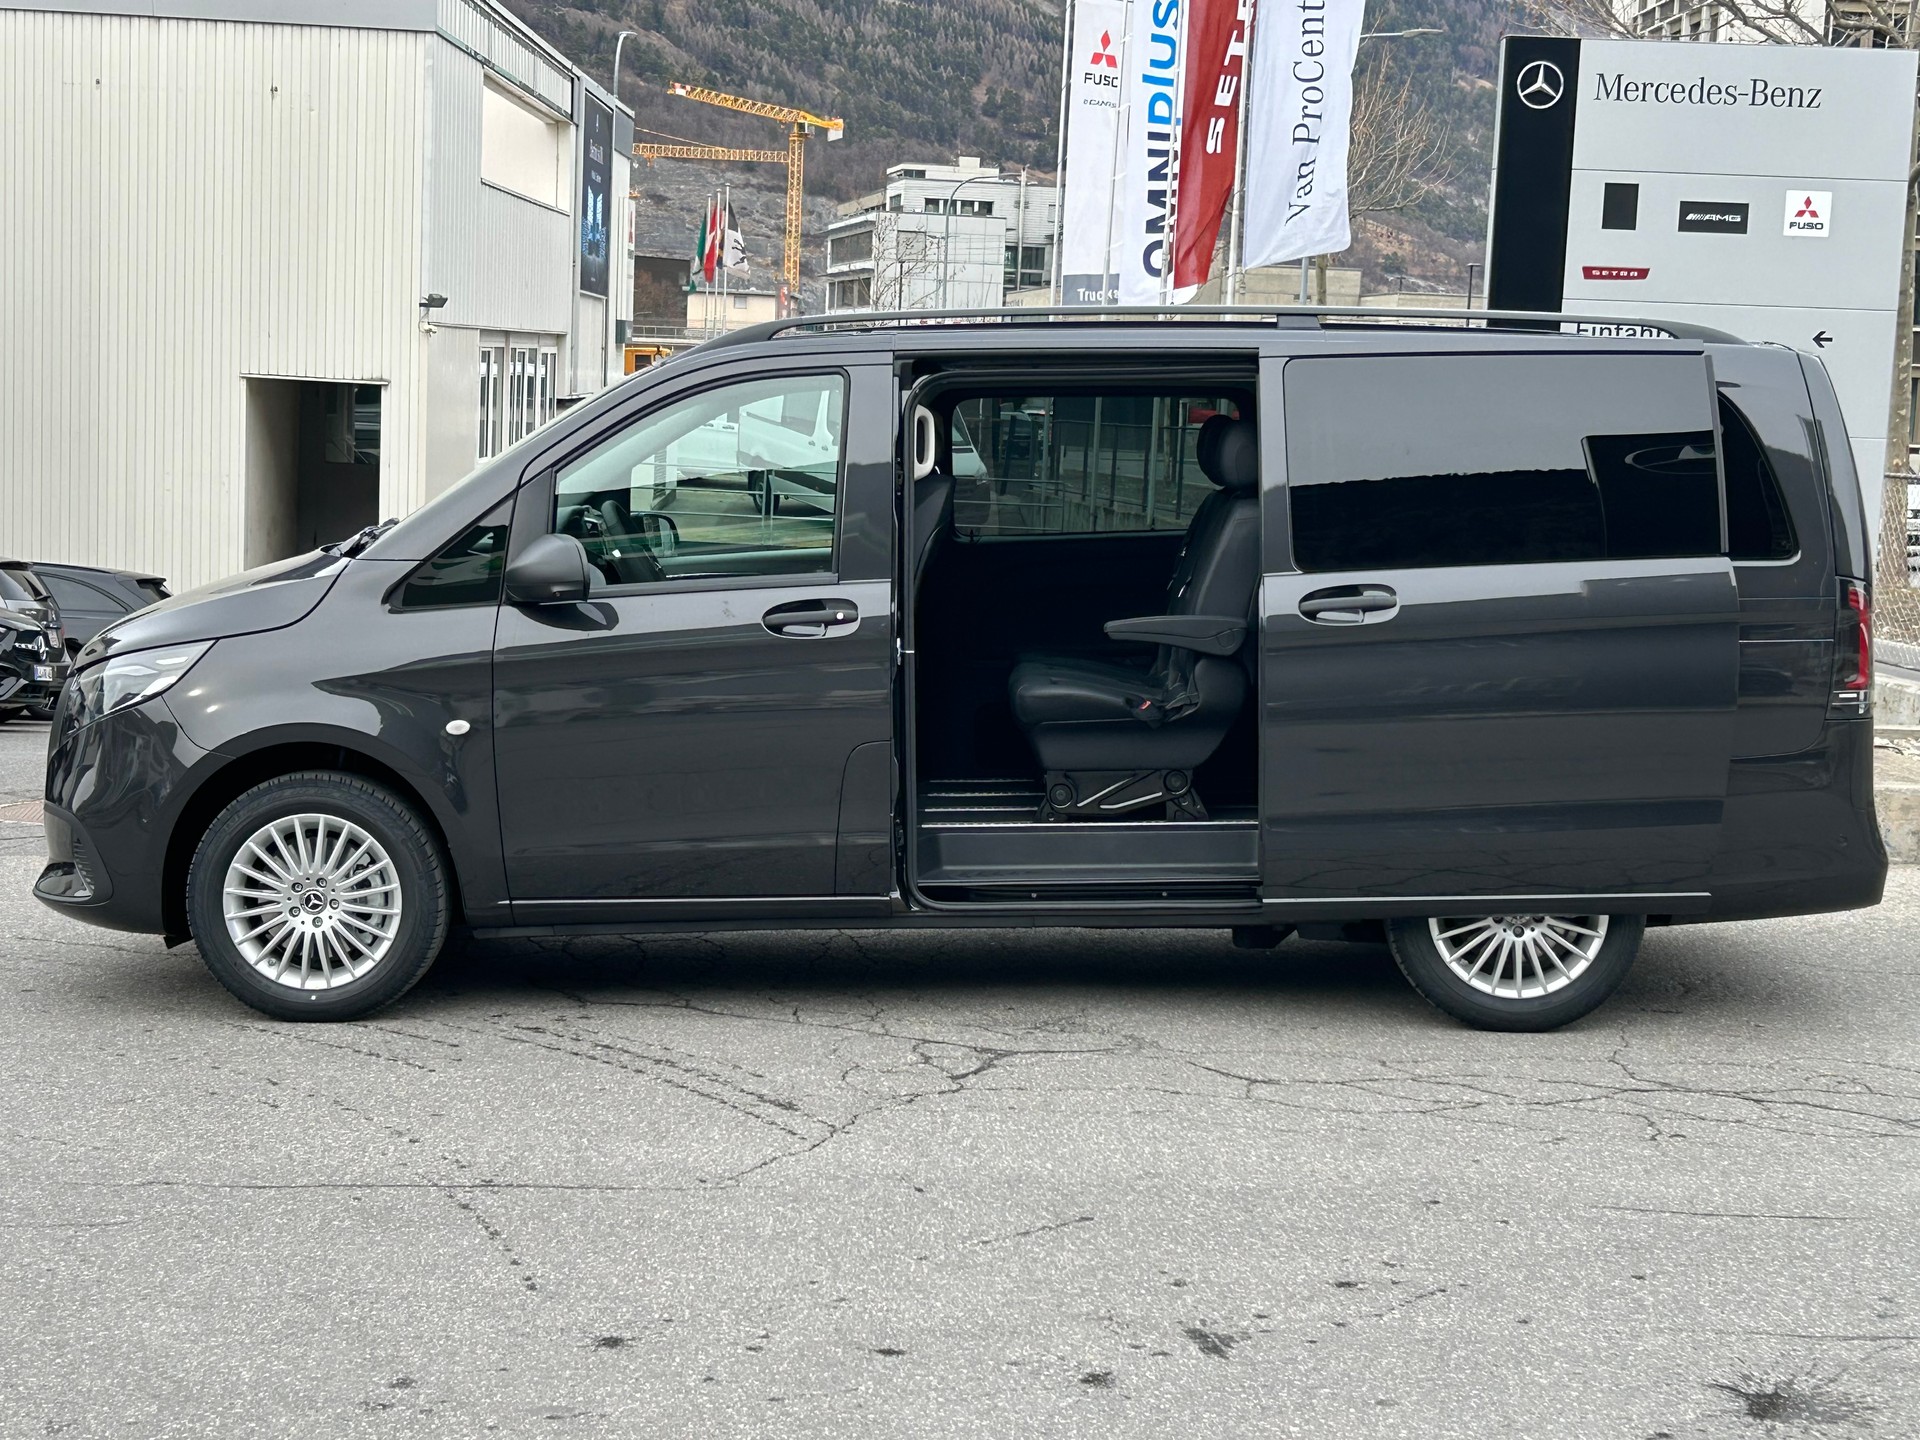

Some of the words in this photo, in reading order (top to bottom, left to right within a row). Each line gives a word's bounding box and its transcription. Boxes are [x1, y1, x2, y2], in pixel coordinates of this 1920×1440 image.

[1594, 73, 1822, 108] Mercedes-Benz
[1284, 156, 1317, 226] Van
[1789, 222, 1824, 230] FUSO
